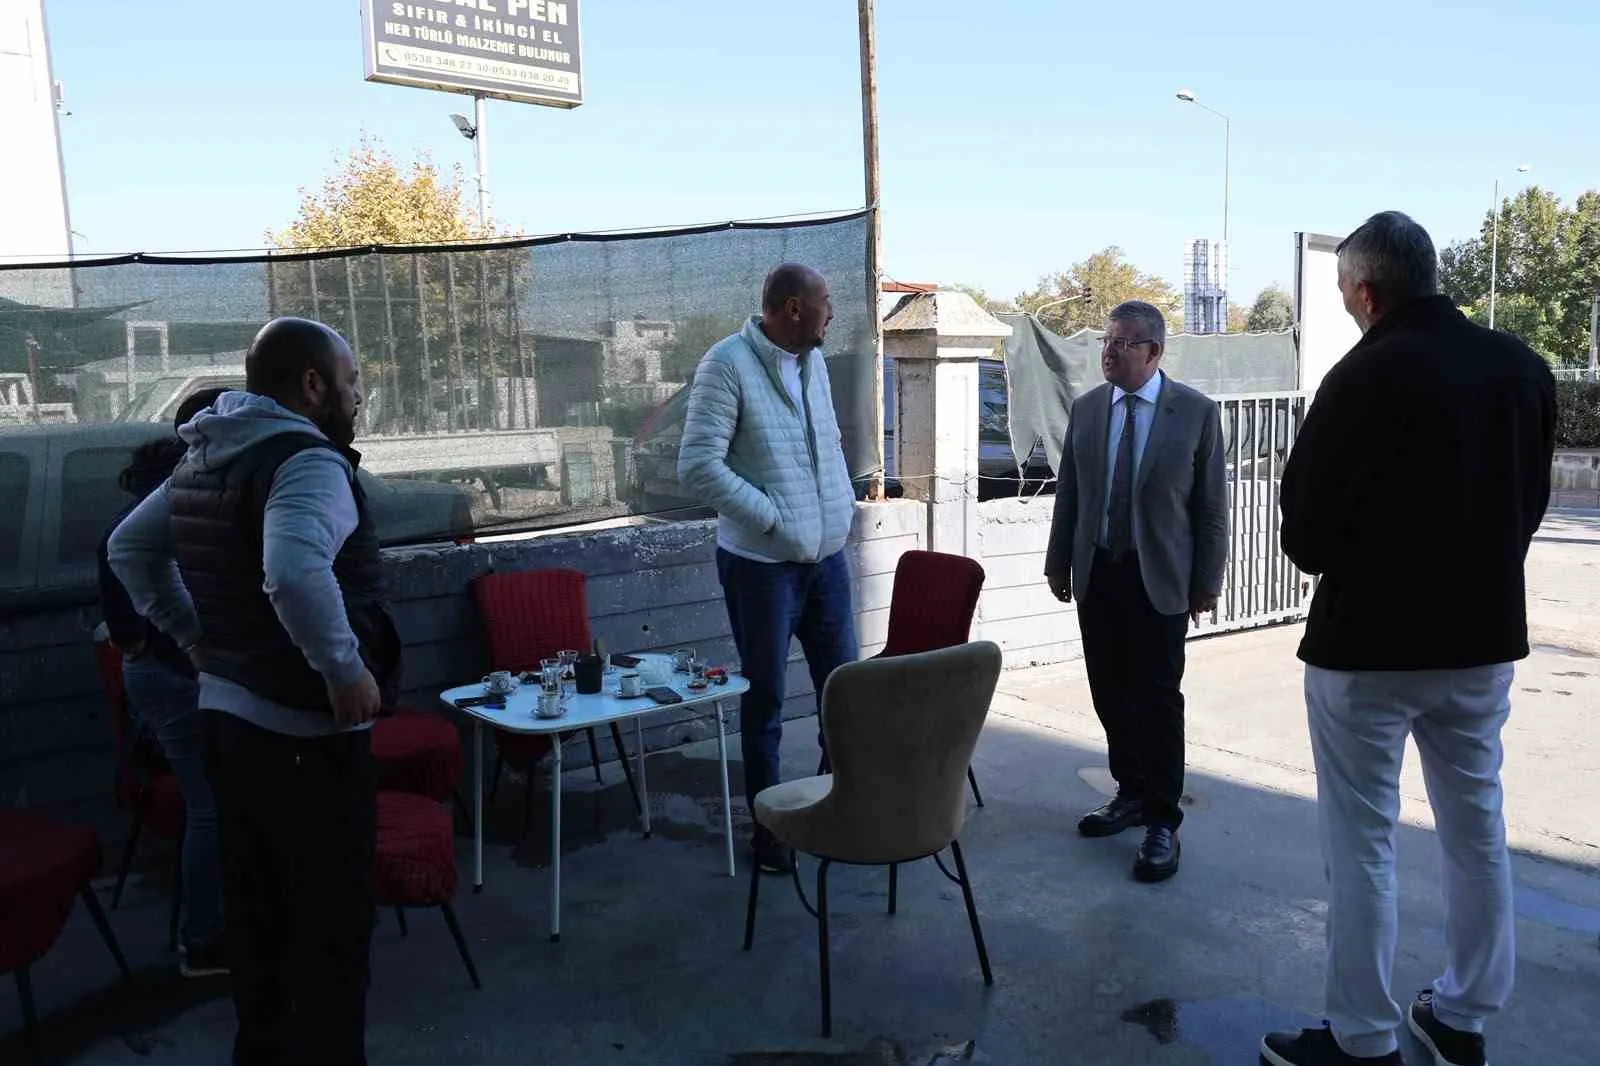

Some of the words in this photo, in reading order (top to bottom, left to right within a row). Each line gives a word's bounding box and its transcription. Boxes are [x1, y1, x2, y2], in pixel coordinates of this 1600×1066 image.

[392, 2, 449, 24] SIFIR
[455, 14, 468, 28] &
[542, 30, 563, 45] EL
[507, 0, 569, 25] PEN
[456, 33, 516, 56] MALZEME
